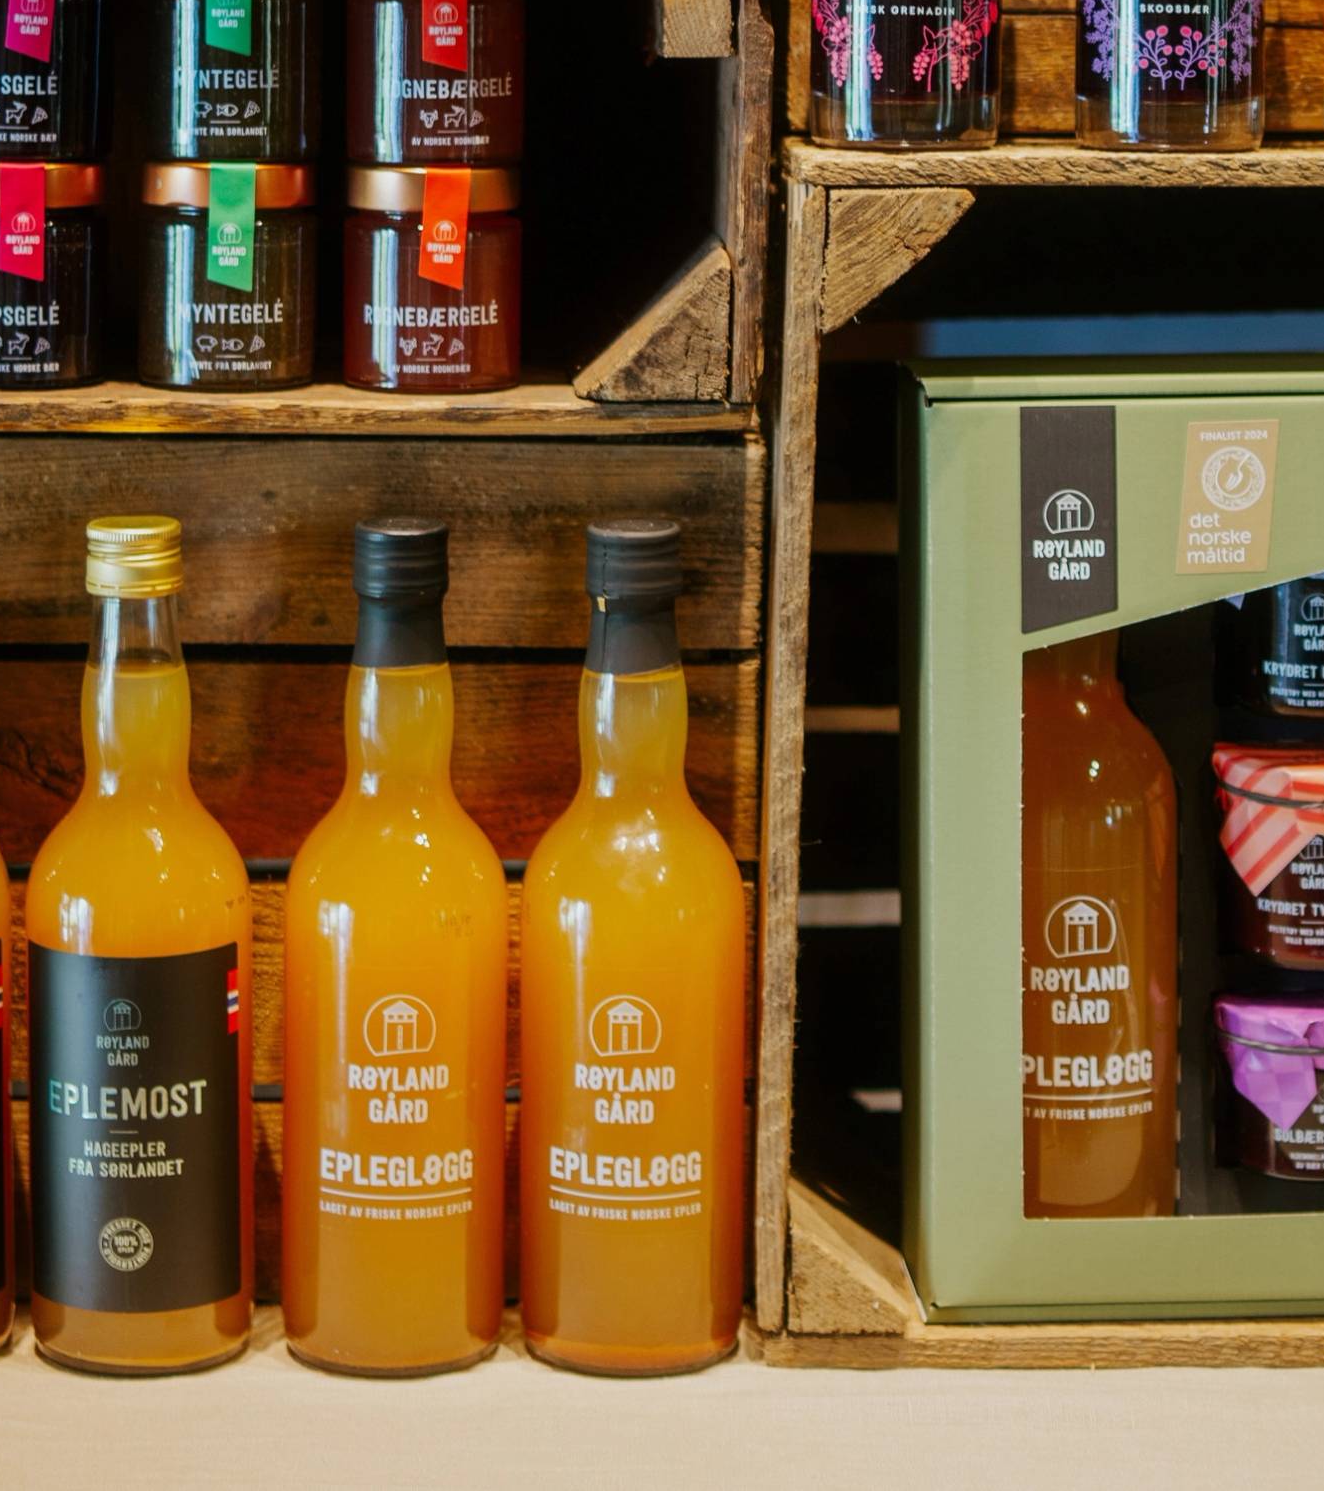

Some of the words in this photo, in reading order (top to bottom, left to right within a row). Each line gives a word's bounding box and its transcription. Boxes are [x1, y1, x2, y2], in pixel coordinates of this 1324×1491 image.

[891, 5, 955, 16] GRENADIN
[1139, 3, 1210, 14] SKOGSBÆR
[1200, 431, 1241, 442] FINALIST
[1244, 430, 1268, 440] 2024
[1189, 512, 1220, 528] det
[1188, 529, 1252, 546] norske
[1033, 540, 1105, 559] RØYLAND
[1187, 547, 1245, 565] måltid
[1048, 558, 1090, 581] GÅRD
[1263, 661, 1317, 679] KRYDRET
[348, 1063, 449, 1091] RØYLAND
[575, 1063, 675, 1091] RØYLAND
[1022, 1050, 1153, 1087] PLEGLØGG
[49, 1080, 207, 1120] EPLEMOST
[369, 1093, 429, 1124] GÅRD
[595, 1093, 654, 1124] GÅRD
[84, 1140, 166, 1158] HAGEEPLER
[69, 1159, 94, 1177] FRA
[100, 1159, 184, 1178] SØRLANDET
[320, 1147, 473, 1187] EPLEGLØGG
[550, 1146, 701, 1188] EPLEGLØGG
[320, 1199, 347, 1216] LAGET
[350, 1203, 363, 1217] AV
[365, 1204, 402, 1220] FRISKE
[405, 1204, 444, 1220] NORSKE
[447, 1199, 473, 1216] EPLER
